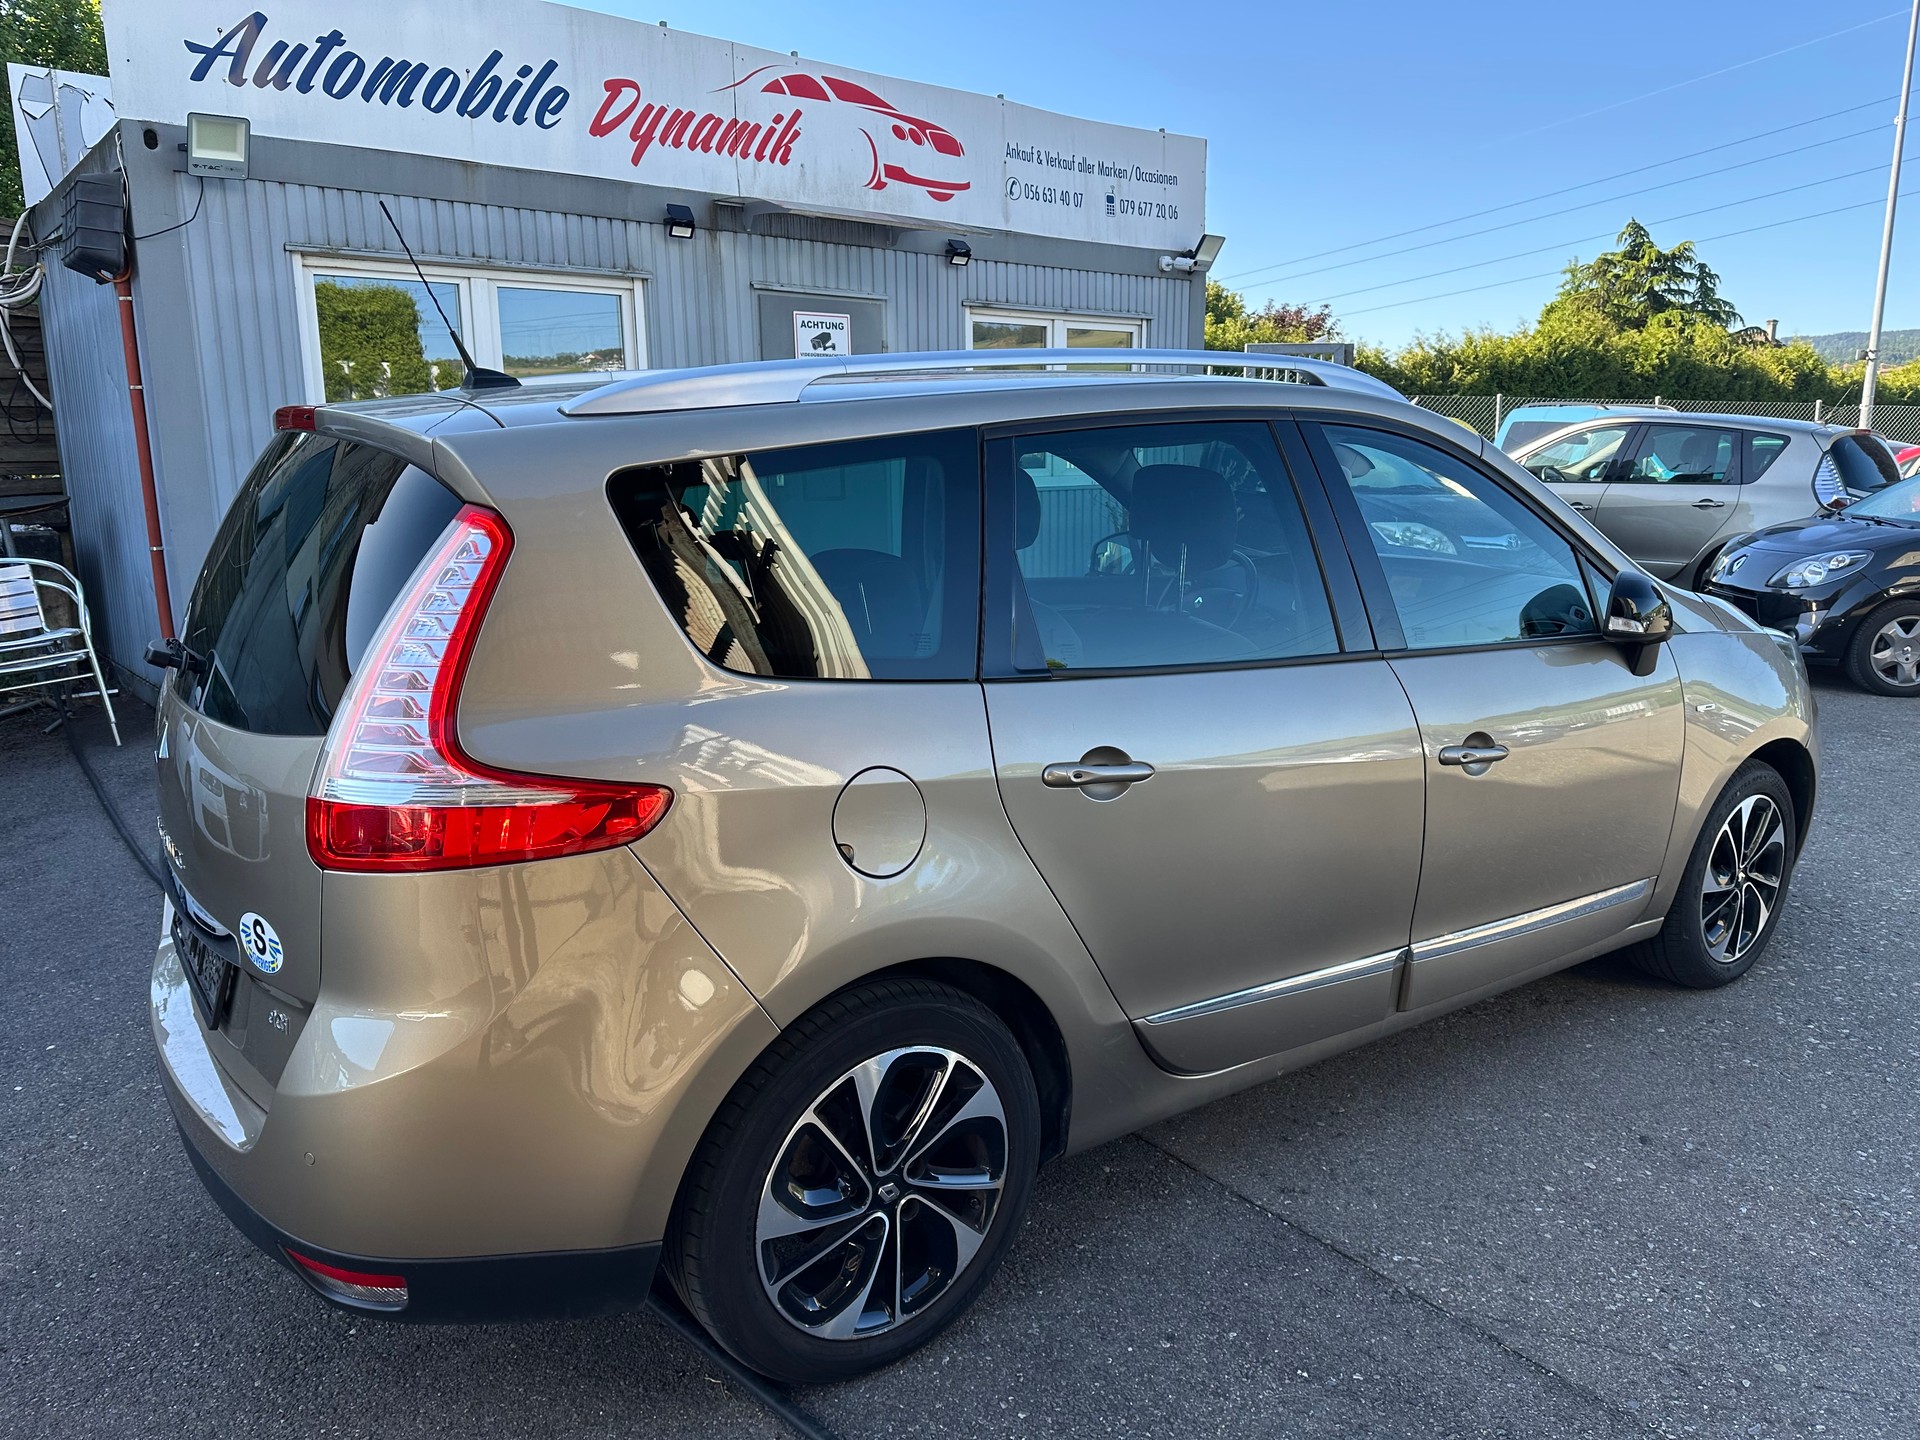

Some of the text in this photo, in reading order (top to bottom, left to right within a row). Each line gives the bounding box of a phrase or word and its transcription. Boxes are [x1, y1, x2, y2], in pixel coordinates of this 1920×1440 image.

[184, 11, 803, 167] Automobile Dynamik
[1006, 142, 1034, 163] Ankauf
[1036, 150, 1043, 166] &
[1044, 150, 1075, 172] Verkauf
[1077, 156, 1095, 175] aller
[1024, 183, 1084, 209] 056 631 40 07
[1119, 198, 1178, 220] 079 677 20 06
[801, 320, 844, 330] ACHTUNG
[253, 918, 267, 956] S
